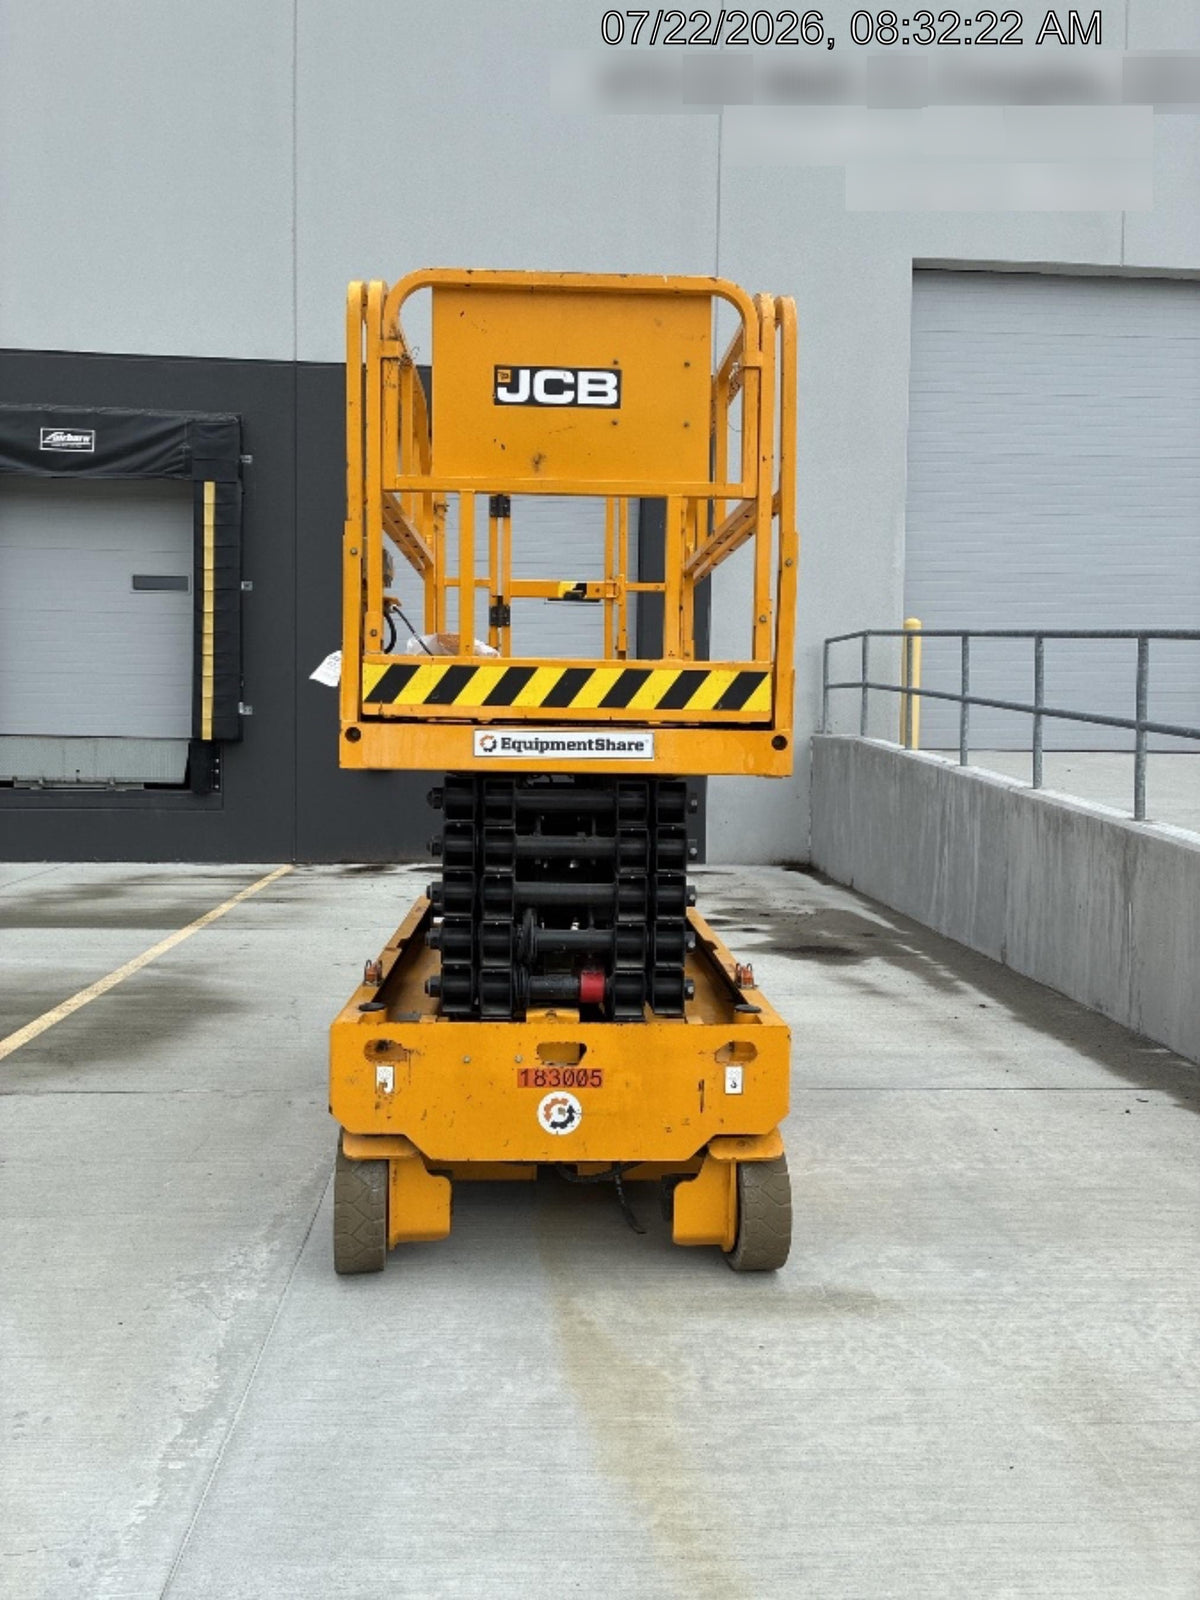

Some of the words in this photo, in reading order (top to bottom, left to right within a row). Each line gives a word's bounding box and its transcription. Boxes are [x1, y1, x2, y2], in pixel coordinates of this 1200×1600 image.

[497, 369, 618, 404] JCB
[500, 737, 644, 753] EquipmentShare
[520, 1068, 603, 1087] 183005
